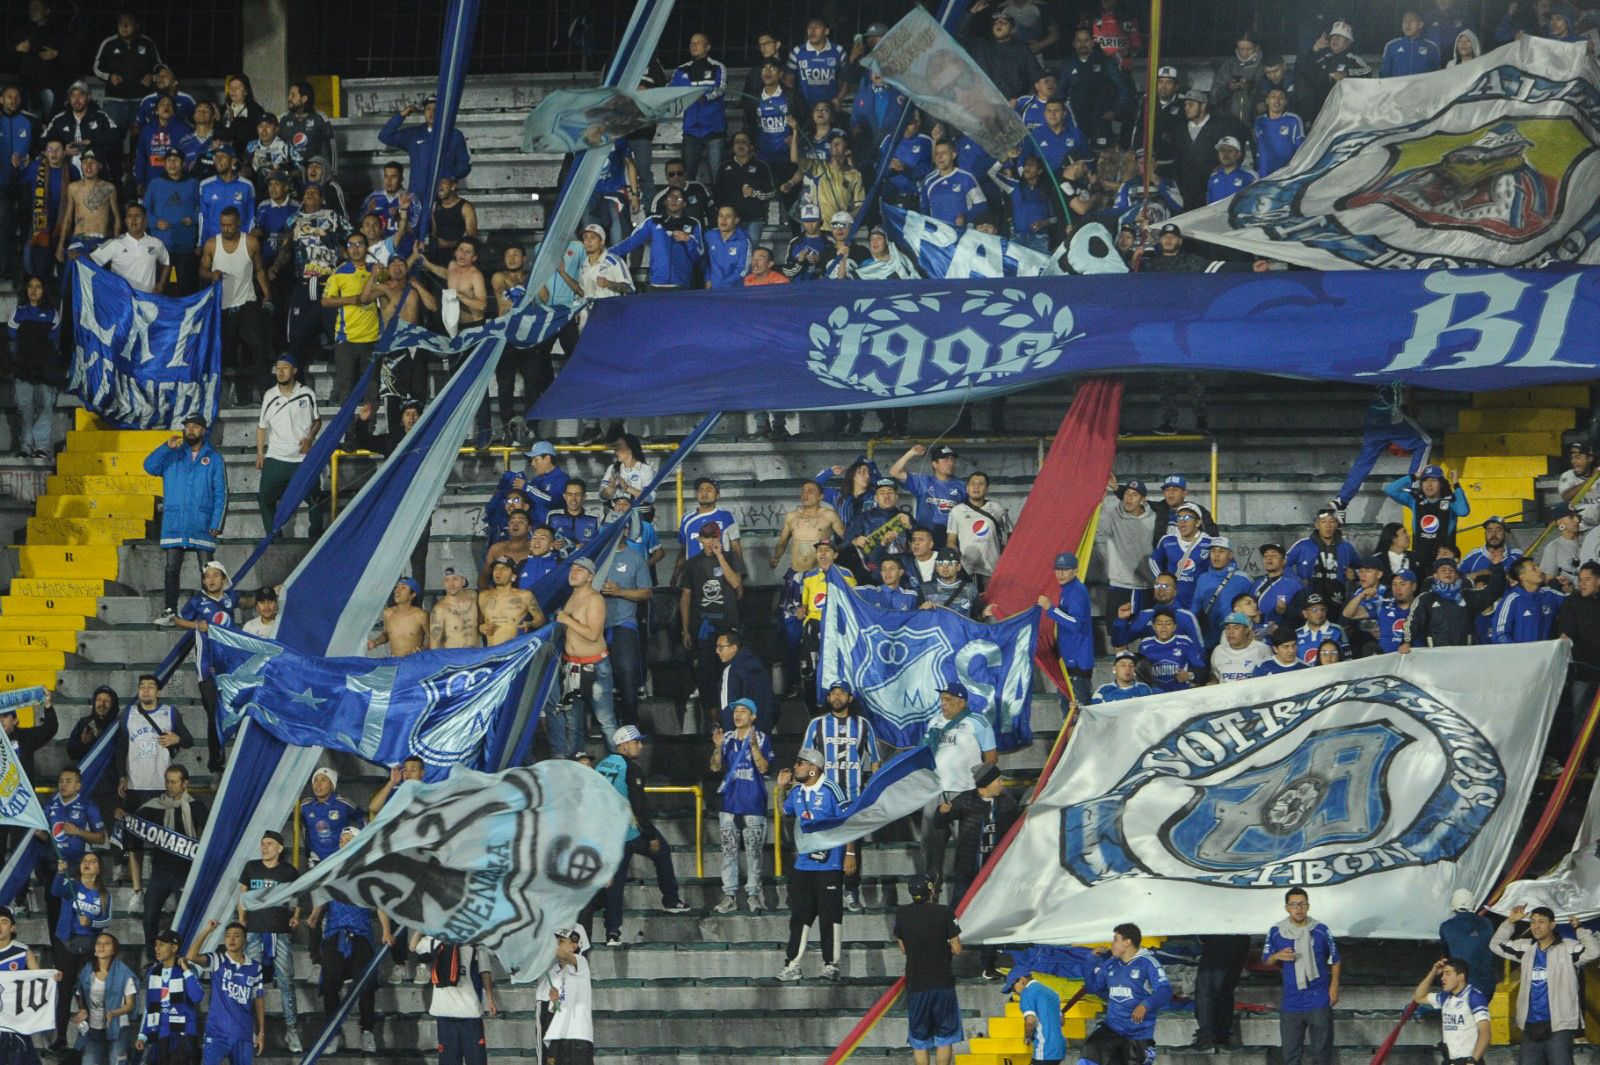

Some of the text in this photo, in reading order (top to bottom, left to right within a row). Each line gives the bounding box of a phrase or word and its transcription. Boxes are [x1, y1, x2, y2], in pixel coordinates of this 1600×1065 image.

[65, 552, 74, 562] R
[26, 635, 35, 646] P
[1222, 672, 1253, 681] PEPS
[824, 761, 862, 770] SAETA
